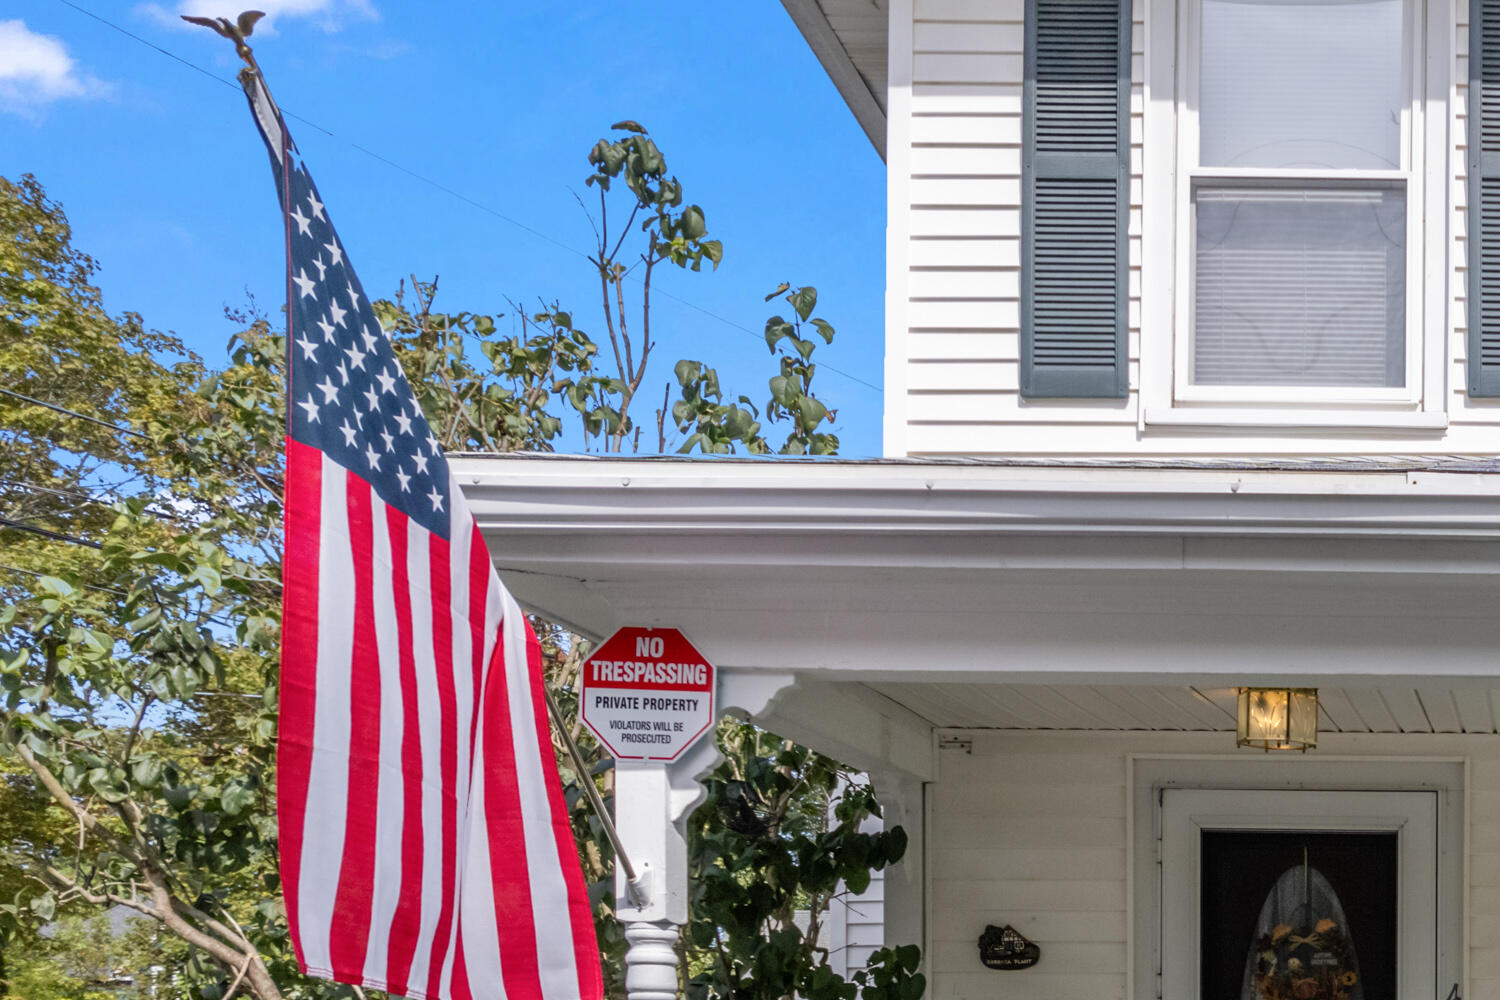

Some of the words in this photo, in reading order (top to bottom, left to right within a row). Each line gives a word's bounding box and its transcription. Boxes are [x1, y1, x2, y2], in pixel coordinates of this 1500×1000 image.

[636, 637, 664, 658] NO
[590, 660, 707, 685] TRESPASSING
[595, 696, 639, 710] PRIVATE
[643, 697, 699, 711] PROPERTY
[609, 720, 651, 731] VIOLATORS
[653, 722, 672, 732] WILL
[673, 722, 684, 732] BE
[621, 733, 672, 744] PROSECUTED
